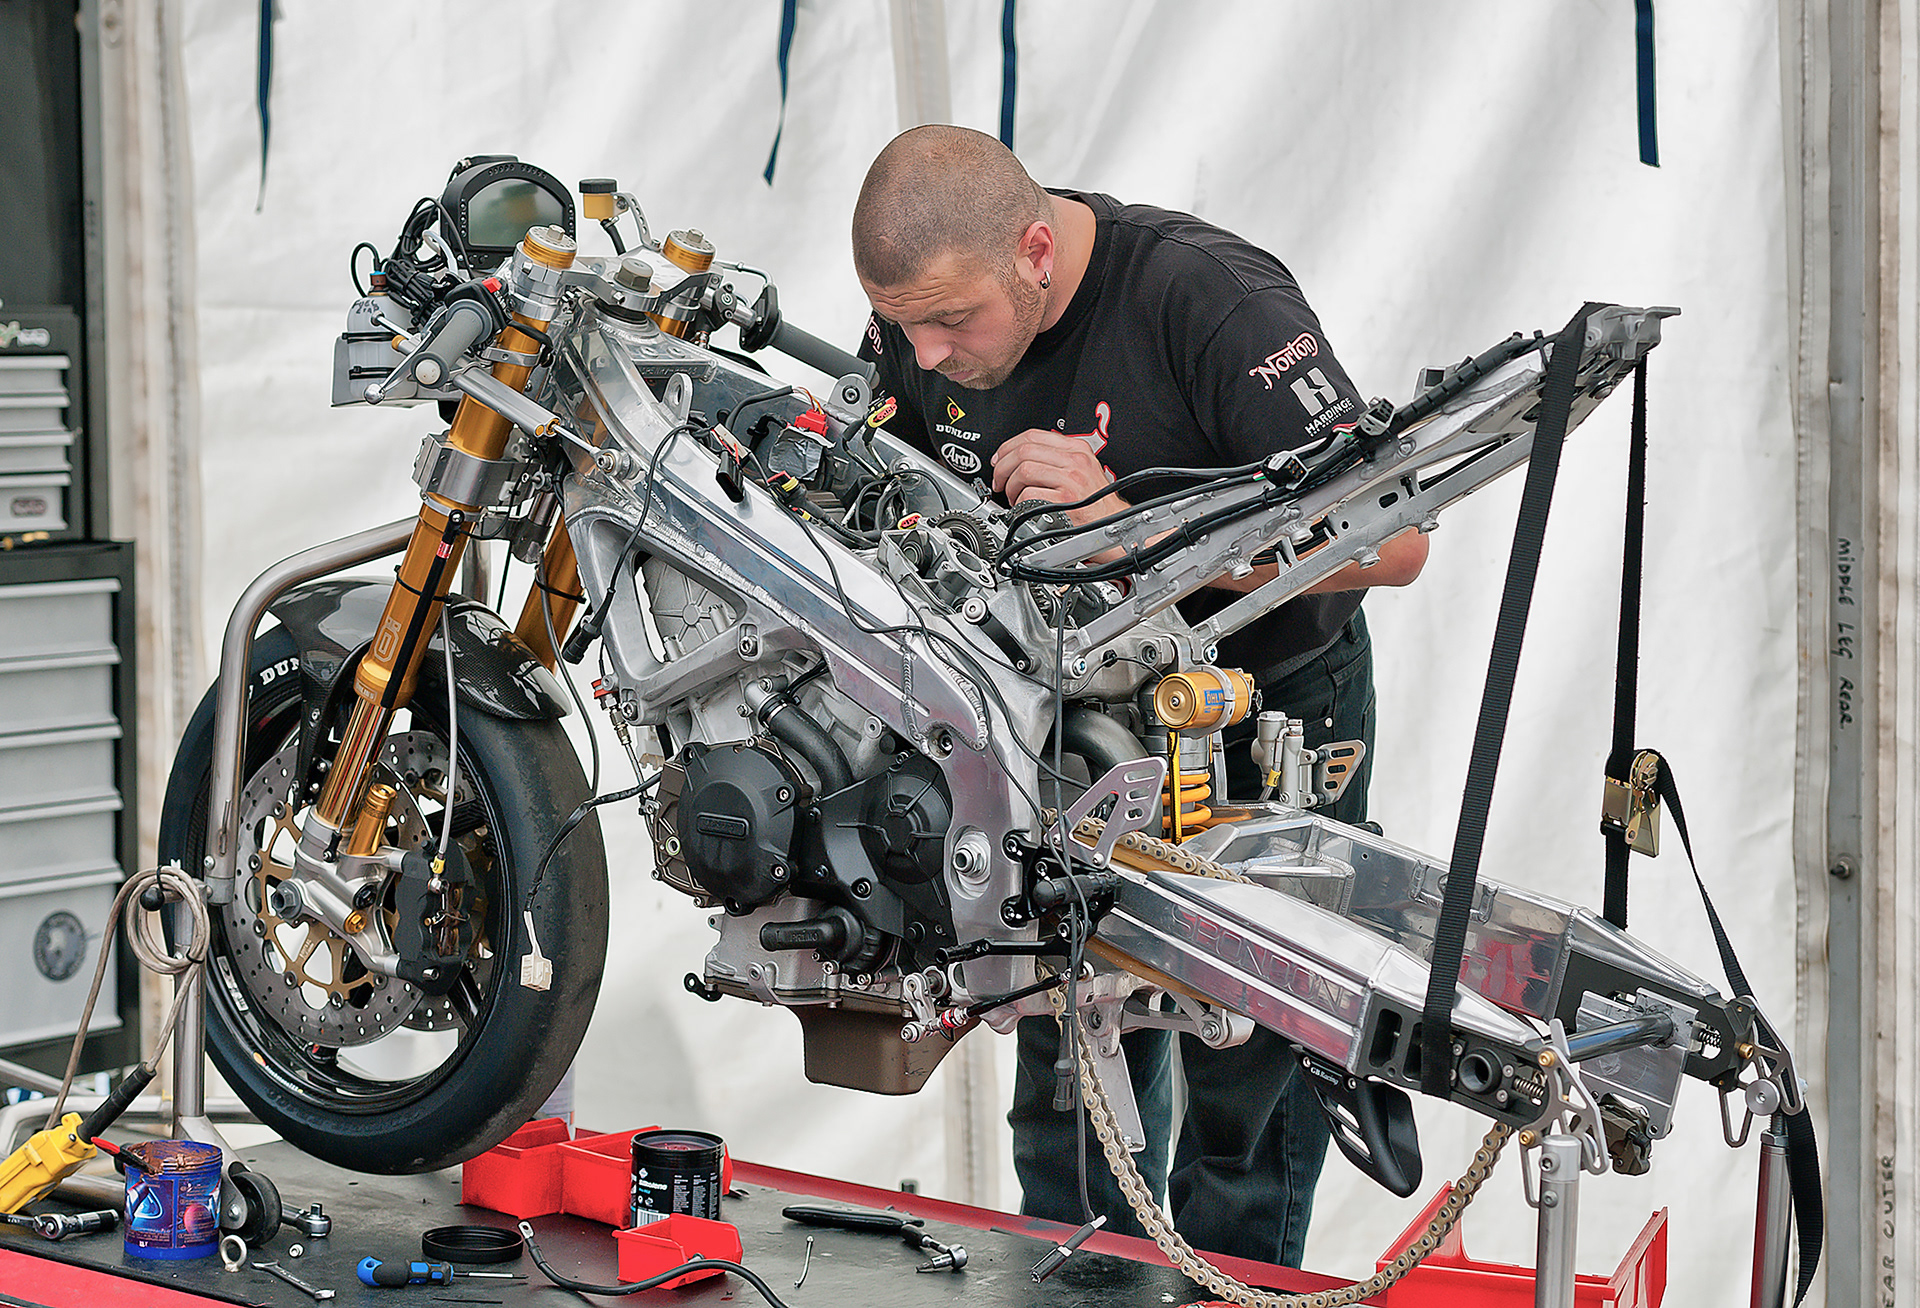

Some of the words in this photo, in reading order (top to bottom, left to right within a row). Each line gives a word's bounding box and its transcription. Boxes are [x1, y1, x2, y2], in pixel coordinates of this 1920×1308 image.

[1248, 331, 1319, 390] Norton
[935, 423, 981, 441] DUNLOP
[1304, 397, 1353, 436] HARDINGE
[944, 446, 976, 468] Arai
[1171, 903, 1343, 1014] SPONDON
